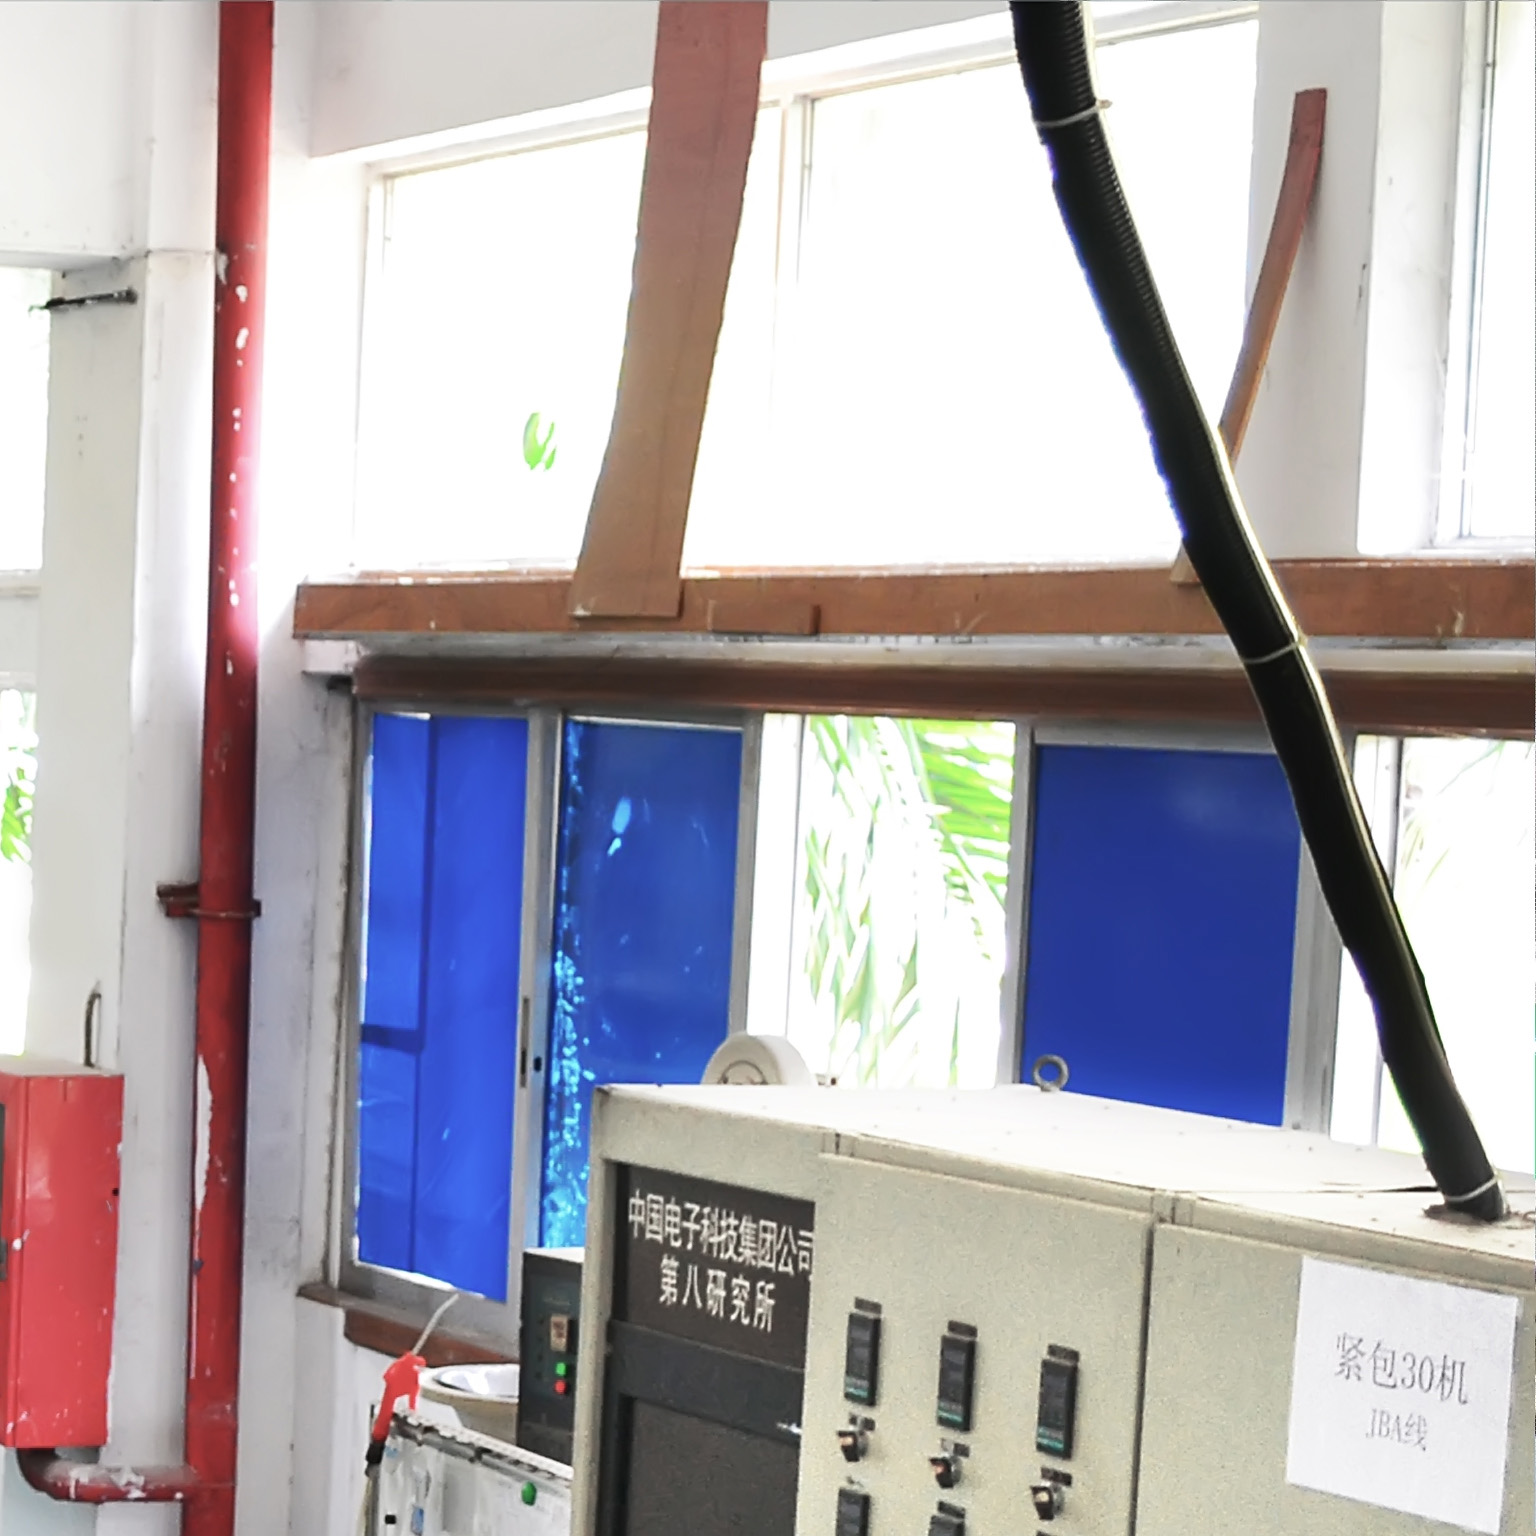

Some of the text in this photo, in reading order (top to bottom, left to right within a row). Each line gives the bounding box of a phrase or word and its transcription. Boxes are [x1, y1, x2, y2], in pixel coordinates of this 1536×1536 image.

[628, 1188, 814, 1277] 中国电子科技集团公司
[659, 1253, 776, 1333] 第八研究所
[1334, 1332, 1469, 1405] 紧包30机
[1365, 1408, 1428, 1452] JBA线
